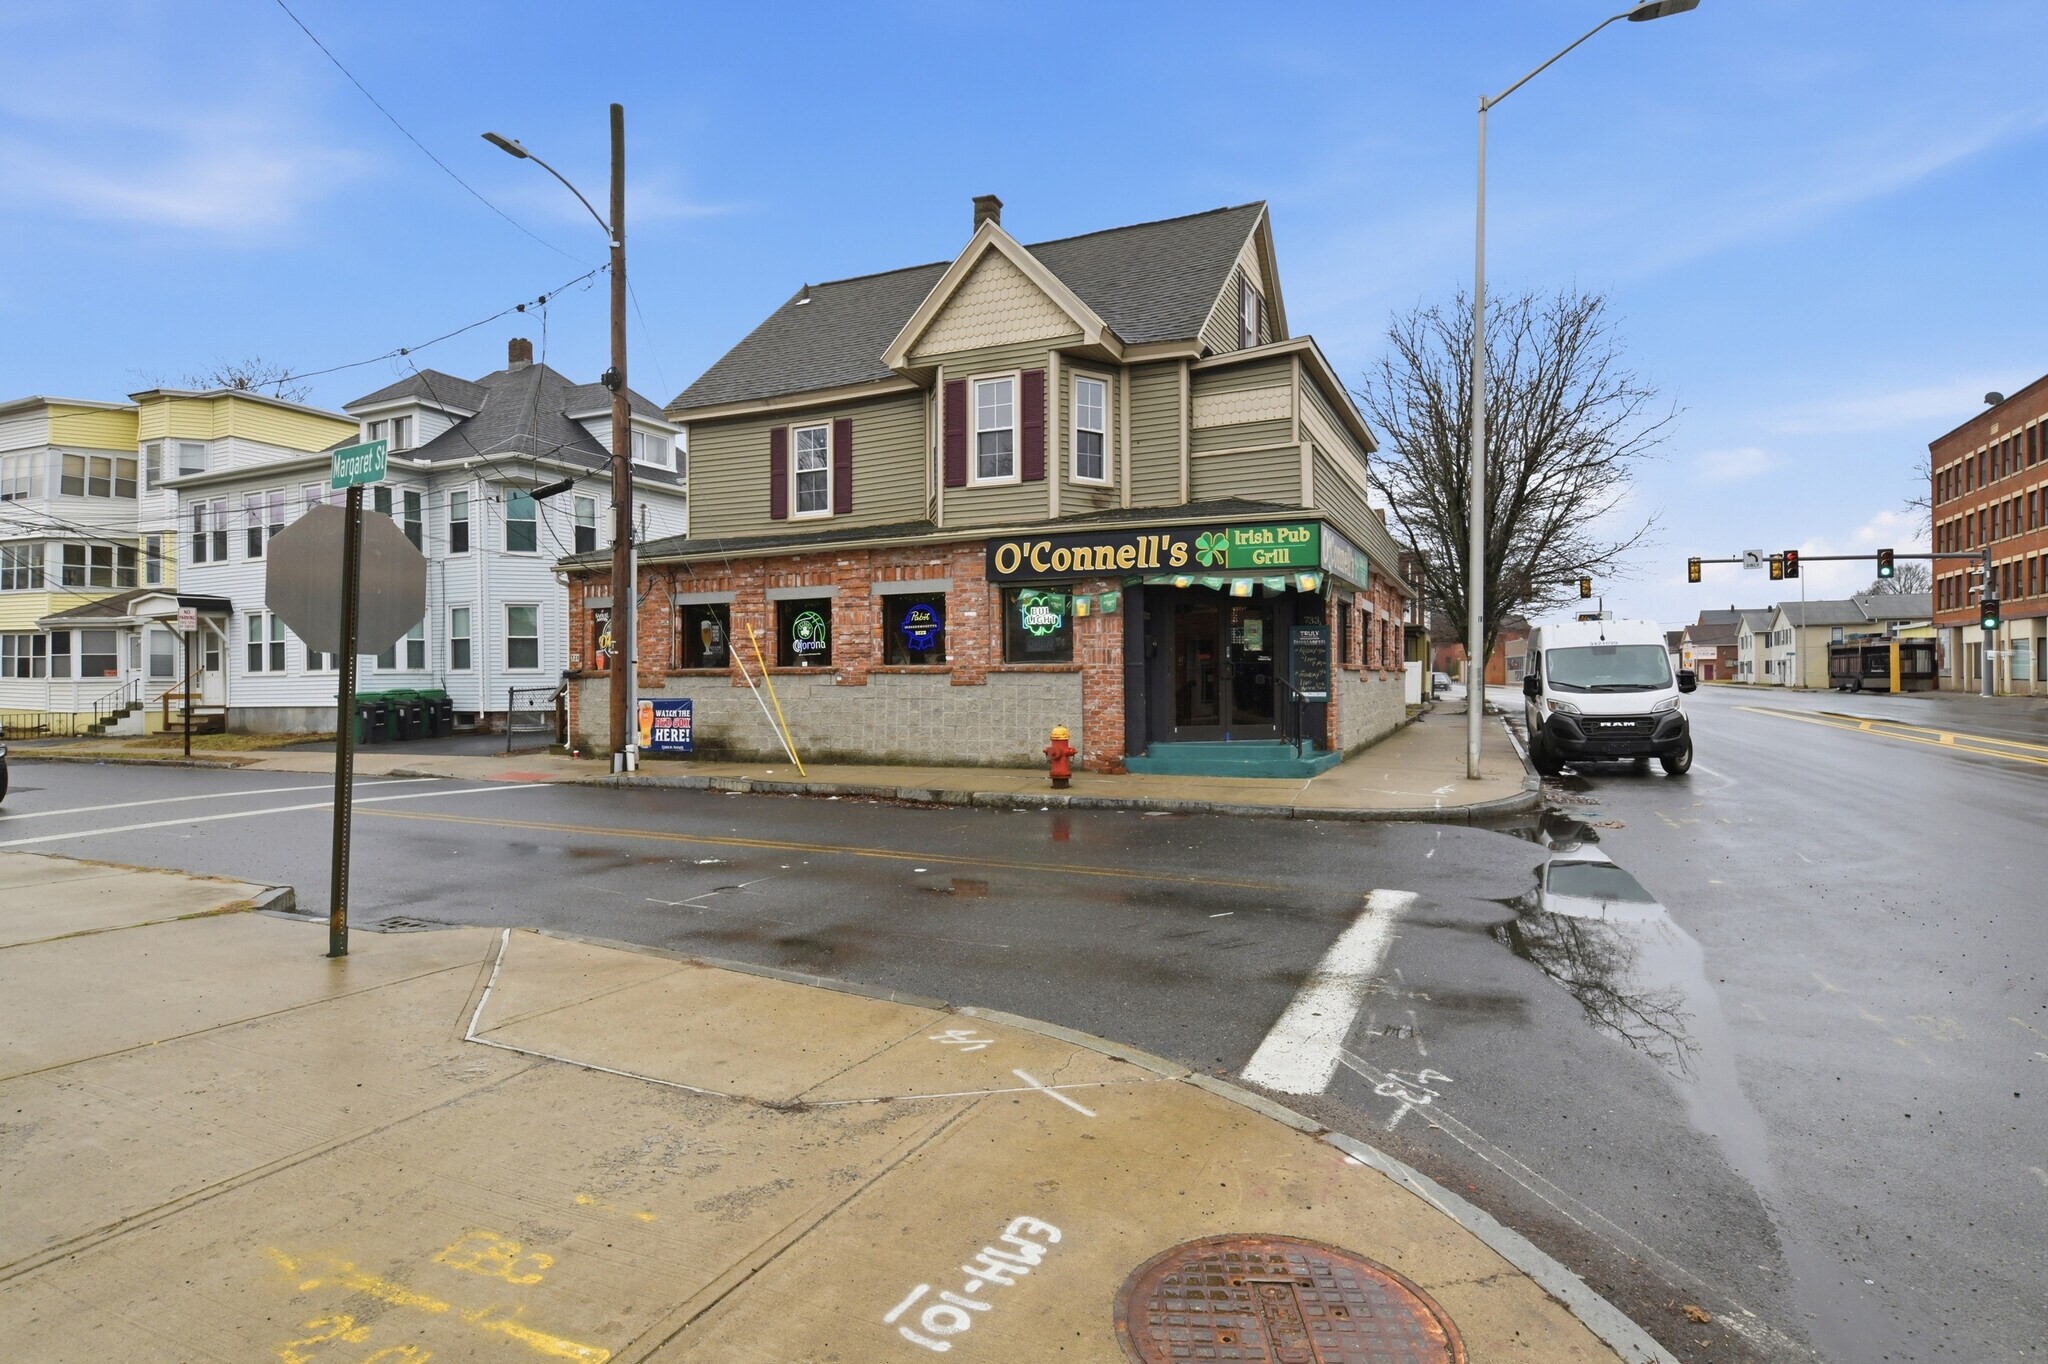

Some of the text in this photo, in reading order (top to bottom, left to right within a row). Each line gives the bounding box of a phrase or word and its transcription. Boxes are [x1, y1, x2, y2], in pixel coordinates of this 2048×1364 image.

[333, 444, 386, 484] Margaret St
[1234, 526, 1311, 546] Irish Pub
[995, 534, 1189, 575] O'Connell's
[1252, 548, 1291, 565] Grill
[911, 610, 931, 622] Pabst
[1027, 615, 1057, 625] LIGHT
[793, 639, 827, 653] Corona
[655, 709, 691, 718] WATCH THE
[655, 717, 691, 729] RED SOX
[655, 728, 691, 743] HERE!
